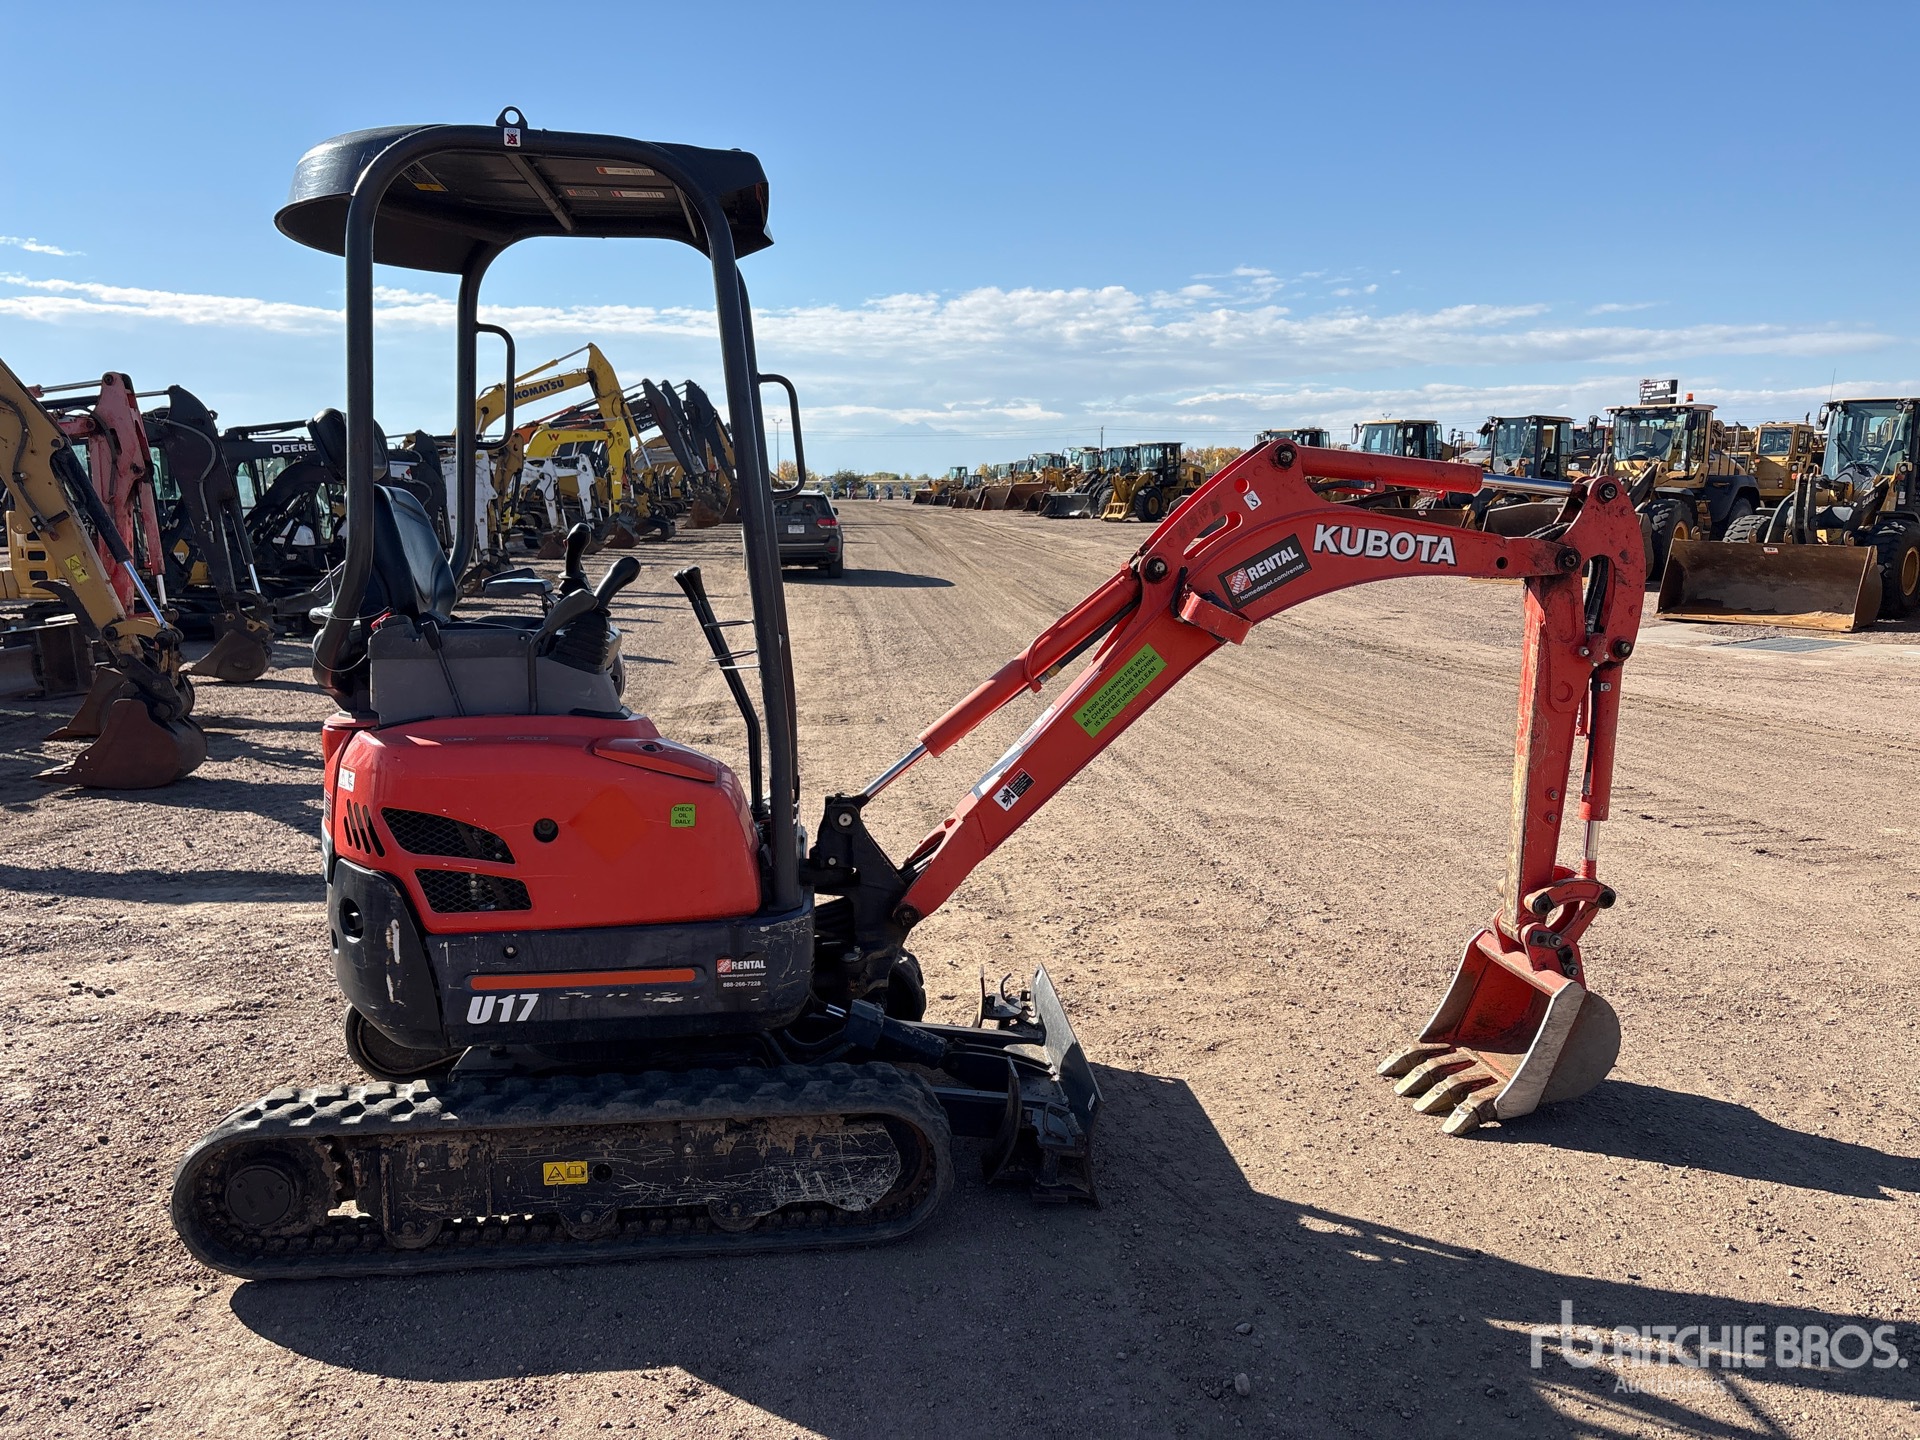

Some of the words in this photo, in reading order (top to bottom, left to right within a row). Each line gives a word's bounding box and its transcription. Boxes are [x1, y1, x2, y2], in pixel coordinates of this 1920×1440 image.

[515, 379, 565, 400] KOMATSU
[271, 443, 316, 454] DEERE
[1313, 523, 1457, 566] KUBOTA
[1240, 562, 1305, 601] homedepot.com/rental
[1246, 546, 1299, 581] RENTAL
[1083, 718, 1092, 727] BE
[1090, 694, 1117, 720] CHARGED
[1115, 688, 1122, 696] IF
[1121, 677, 1134, 690] THIS
[1132, 654, 1158, 678] MACHINE
[1086, 701, 1100, 713] $200
[1098, 676, 1125, 701] CLEANING
[1123, 665, 1136, 678] FEE
[1134, 654, 1149, 667] WILL
[1099, 709, 1112, 721] NOT
[1110, 684, 1139, 710] RETURNED
[1138, 665, 1157, 685] CLEAN
[731, 960, 767, 970] RENTAL
[466, 993, 540, 1025] U17
